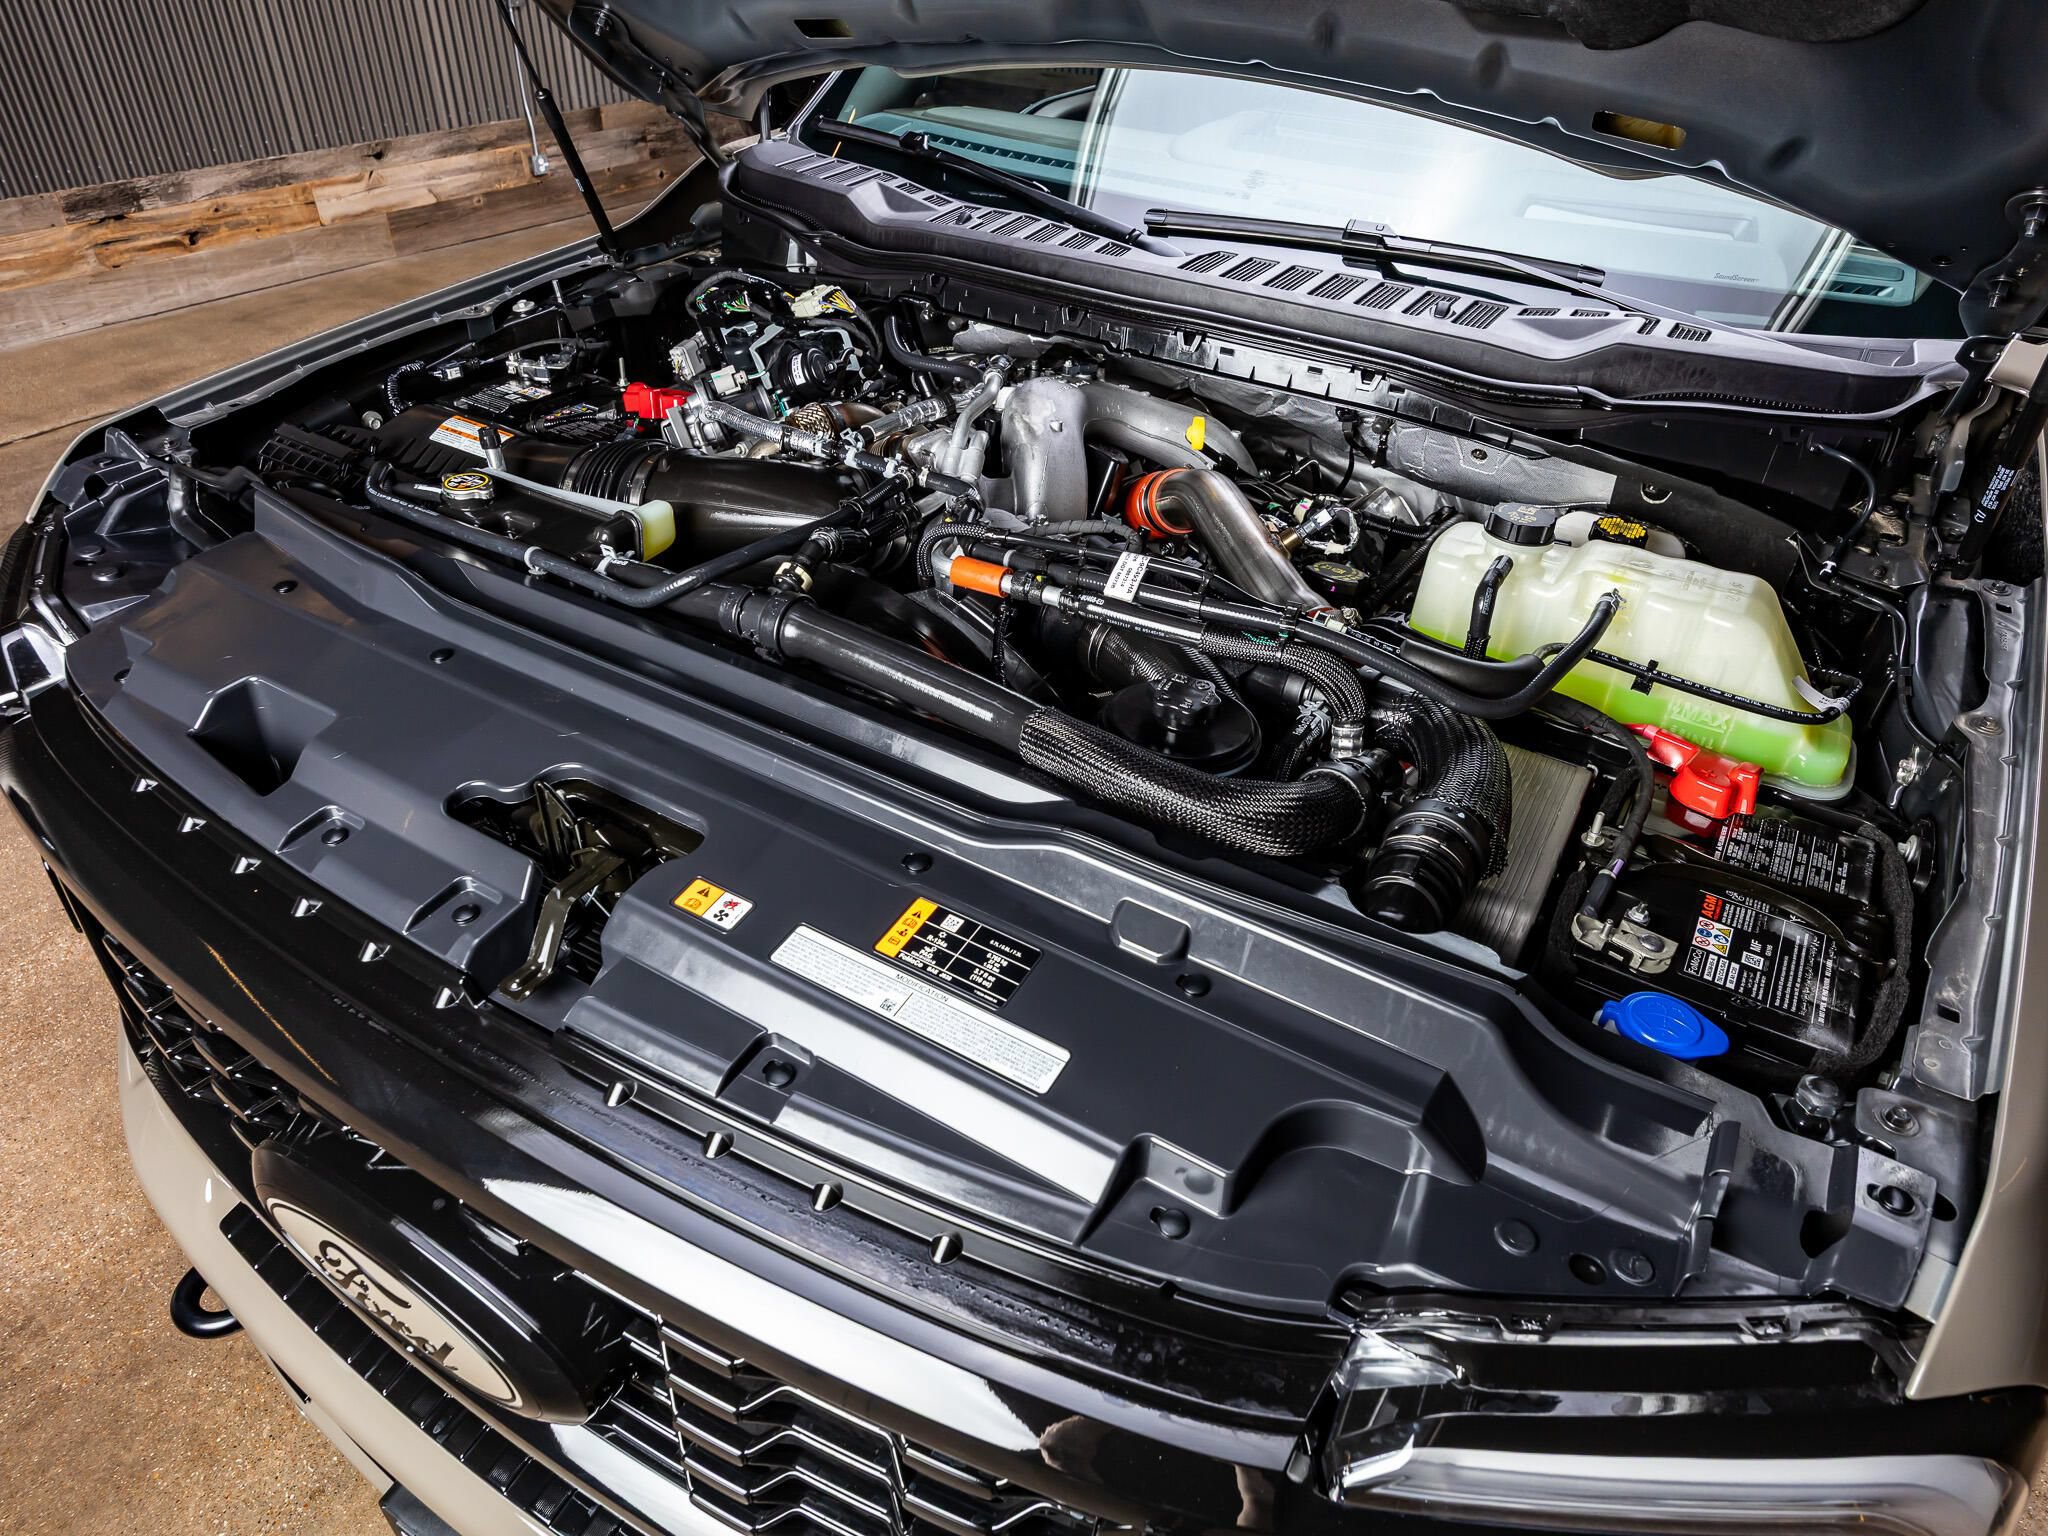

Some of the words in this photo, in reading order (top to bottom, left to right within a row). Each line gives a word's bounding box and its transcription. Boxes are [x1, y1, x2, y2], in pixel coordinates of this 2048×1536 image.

[1701, 894, 1718, 919] AGM
[897, 952, 925, 968] FoMoCo
[895, 973, 949, 1003] MODIFICATION
[314, 1238, 459, 1372] Ford
